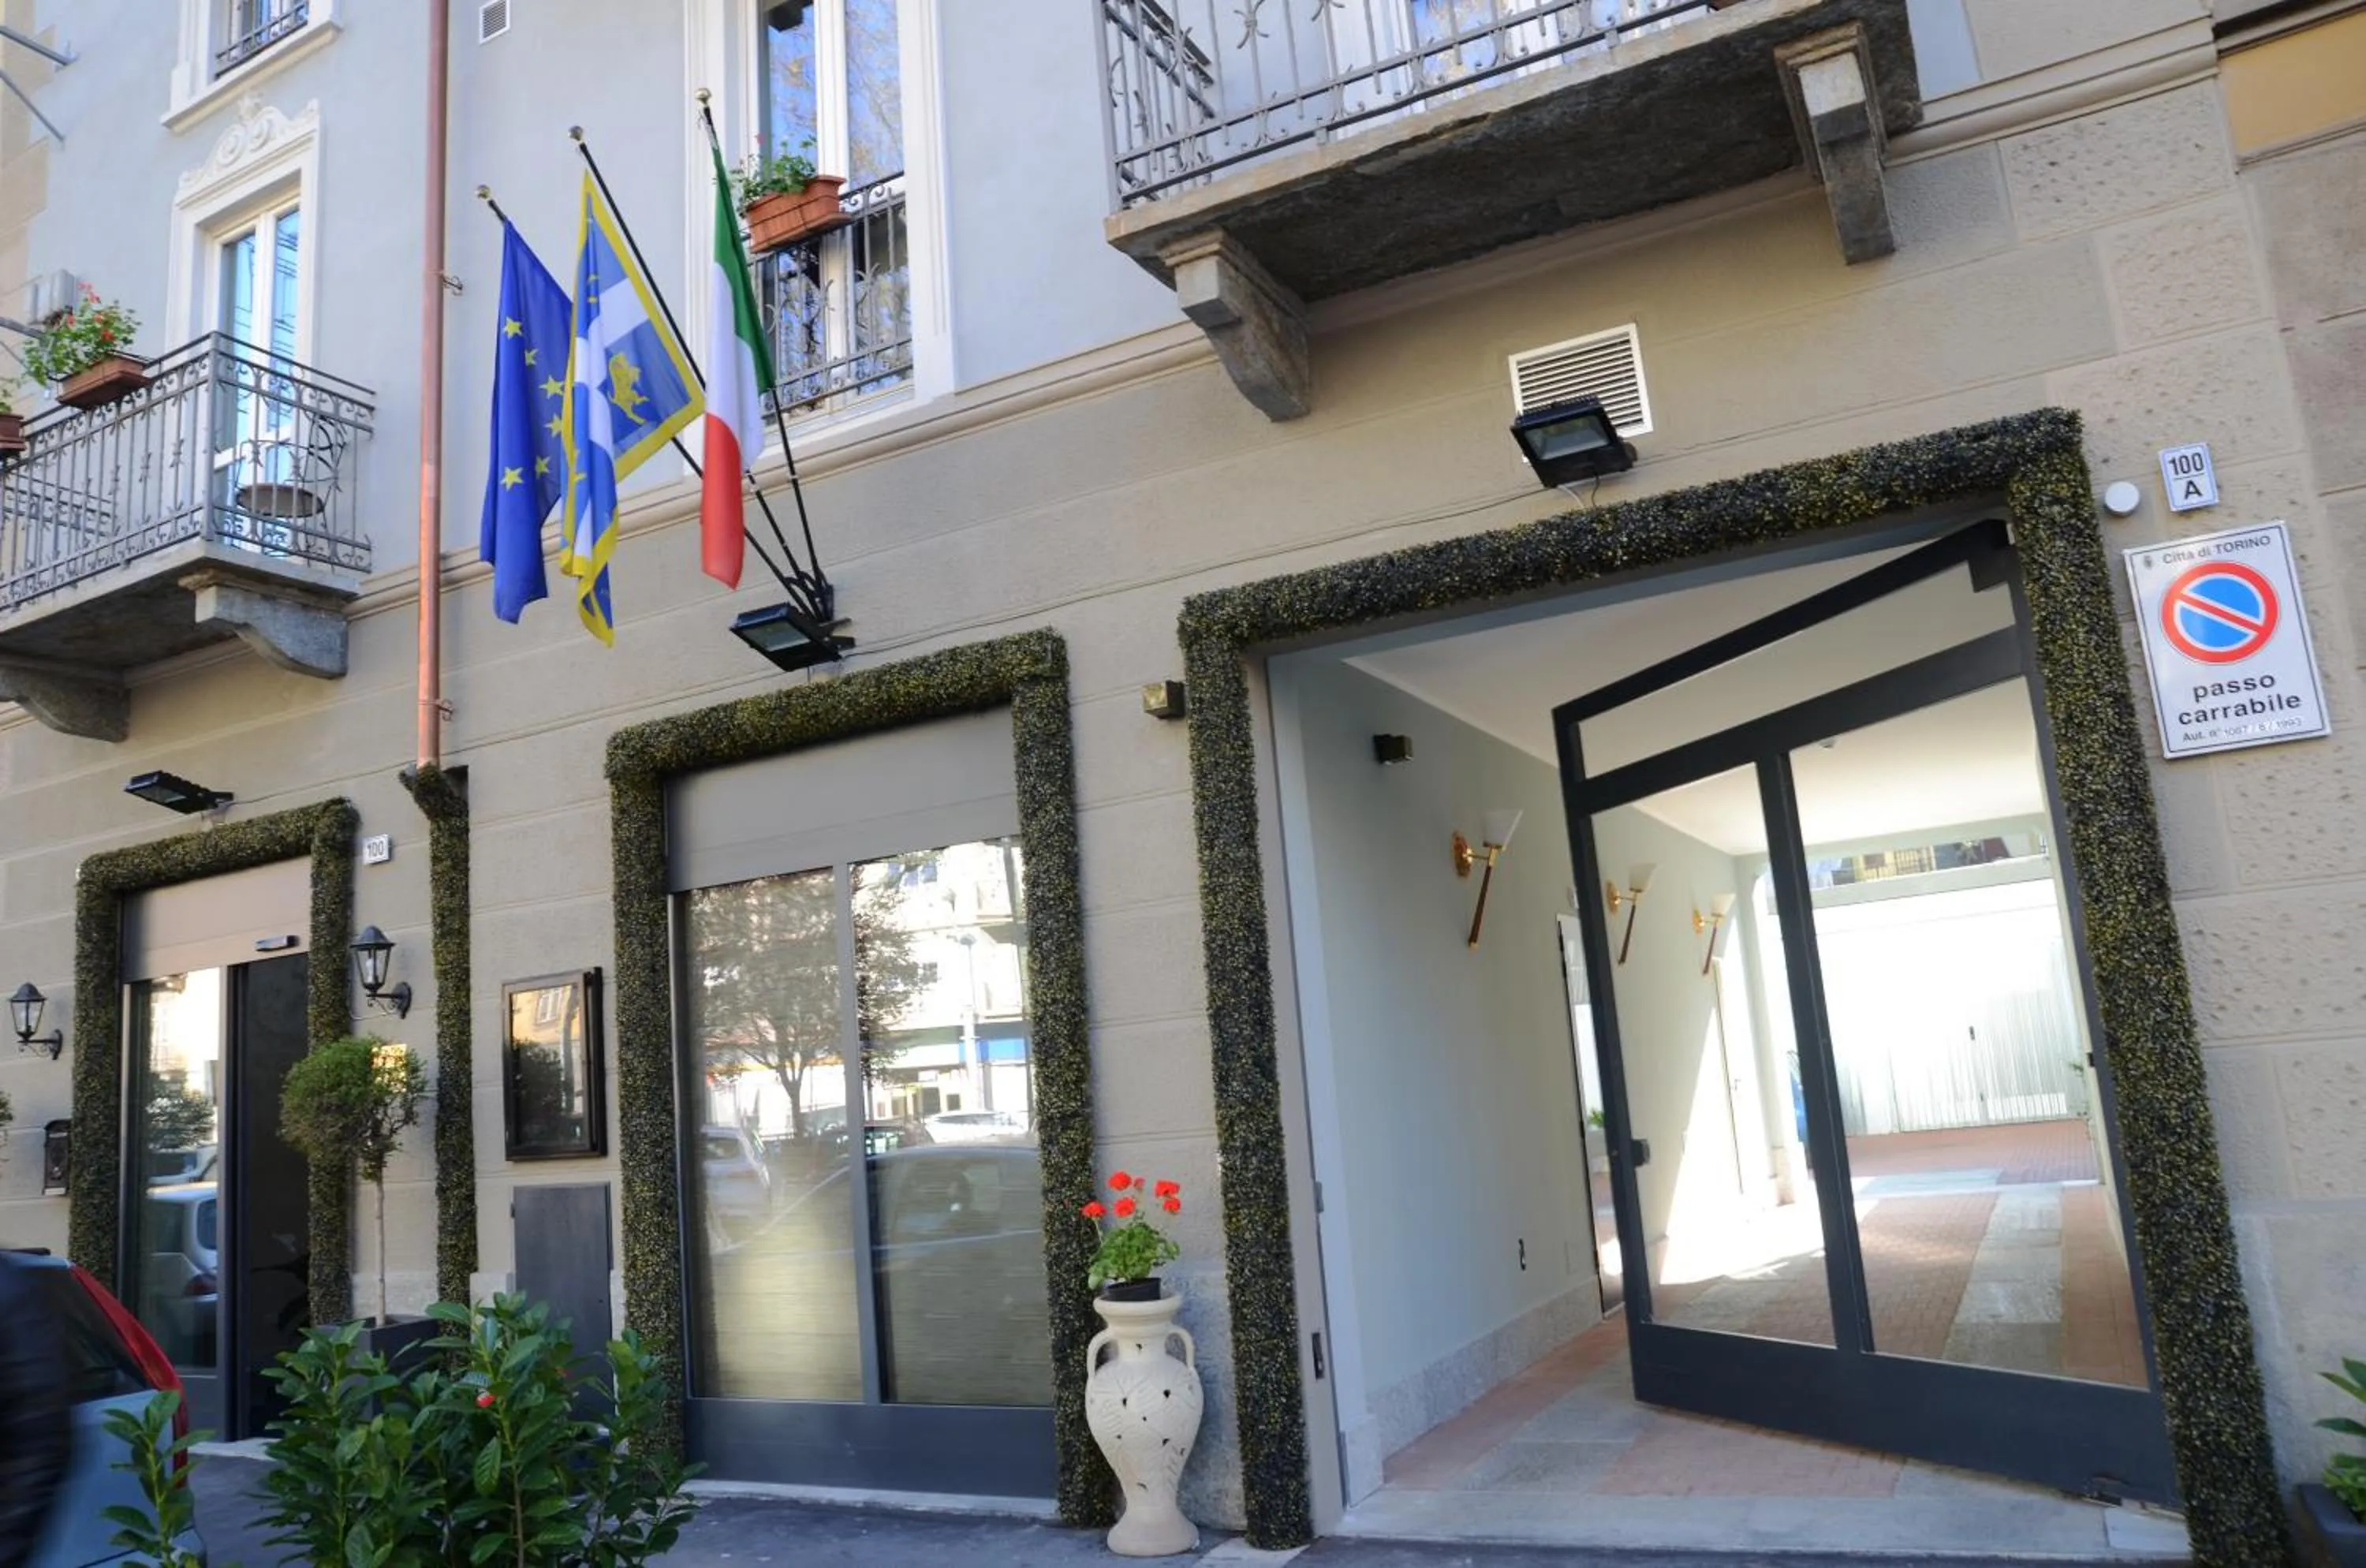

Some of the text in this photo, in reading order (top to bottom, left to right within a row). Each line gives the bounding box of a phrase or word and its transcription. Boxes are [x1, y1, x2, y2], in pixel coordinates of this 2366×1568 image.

[2168, 452, 2204, 476] 100
[2184, 480, 2203, 499] A
[2197, 546, 2211, 558] di
[2215, 536, 2271, 554] TORINO
[2192, 674, 2275, 703] passo
[2178, 693, 2301, 725] carrabile
[367, 840, 384, 858] 100
